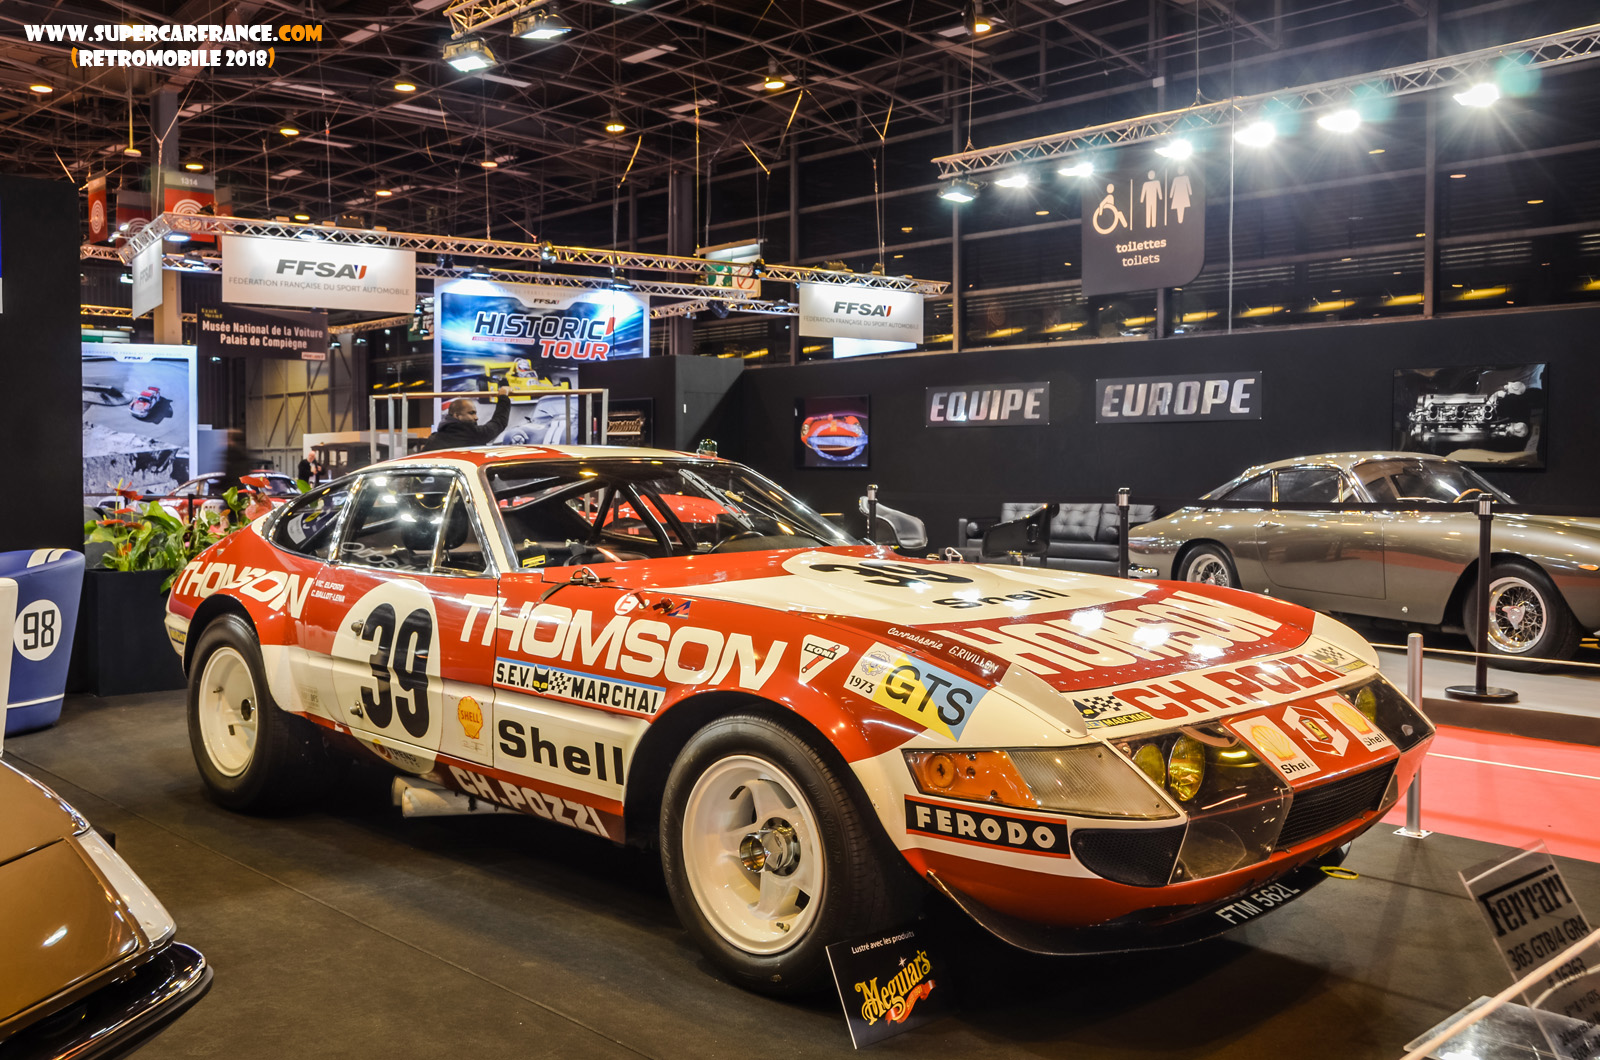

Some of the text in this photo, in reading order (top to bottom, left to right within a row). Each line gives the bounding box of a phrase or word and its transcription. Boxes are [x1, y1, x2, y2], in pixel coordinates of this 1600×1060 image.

[1115, 238, 1167, 254] toilettes
[276, 259, 360, 280] FFSA
[1122, 253, 1160, 268] toilets
[280, 281, 321, 291] FRANÇAISE
[337, 284, 360, 293] SPORT
[362, 286, 410, 296] AUTOMOBILE
[833, 301, 885, 317] FFSA
[202, 320, 323, 338] Musée National de la Voiture
[474, 311, 606, 341] HISTORIC
[872, 320, 888, 328] SPORT
[220, 333, 307, 350] Palais de Compiègne
[540, 340, 610, 361] TOUR
[930, 388, 1044, 422] EQUIPE
[1101, 378, 1255, 417] EUROPE
[809, 561, 974, 587] 39
[23, 610, 55, 650] 98
[460, 593, 788, 691] THOMSON
[887, 627, 943, 650] Carrosserie
[804, 642, 836, 660] KONI
[360, 603, 433, 738] 39
[496, 663, 658, 714] S.E.V. MARCHAL
[849, 675, 876, 694] 1973
[885, 664, 973, 727] GTS
[461, 710, 480, 723] SHELL
[1102, 712, 1152, 727] MARCHAL
[1363, 733, 1387, 746] Shell
[499, 719, 624, 787] Shell
[1281, 759, 1314, 774] Shel
[916, 806, 1057, 849] FERODO
[1215, 882, 1301, 925] FTM 562L
[1477, 864, 1573, 938] Ferrari
[851, 930, 915, 955] Lustré avec les produits
[1507, 942, 1533, 972] 365
[1530, 925, 1568, 959] GTB/4
[854, 950, 932, 1025] Meguiar's
